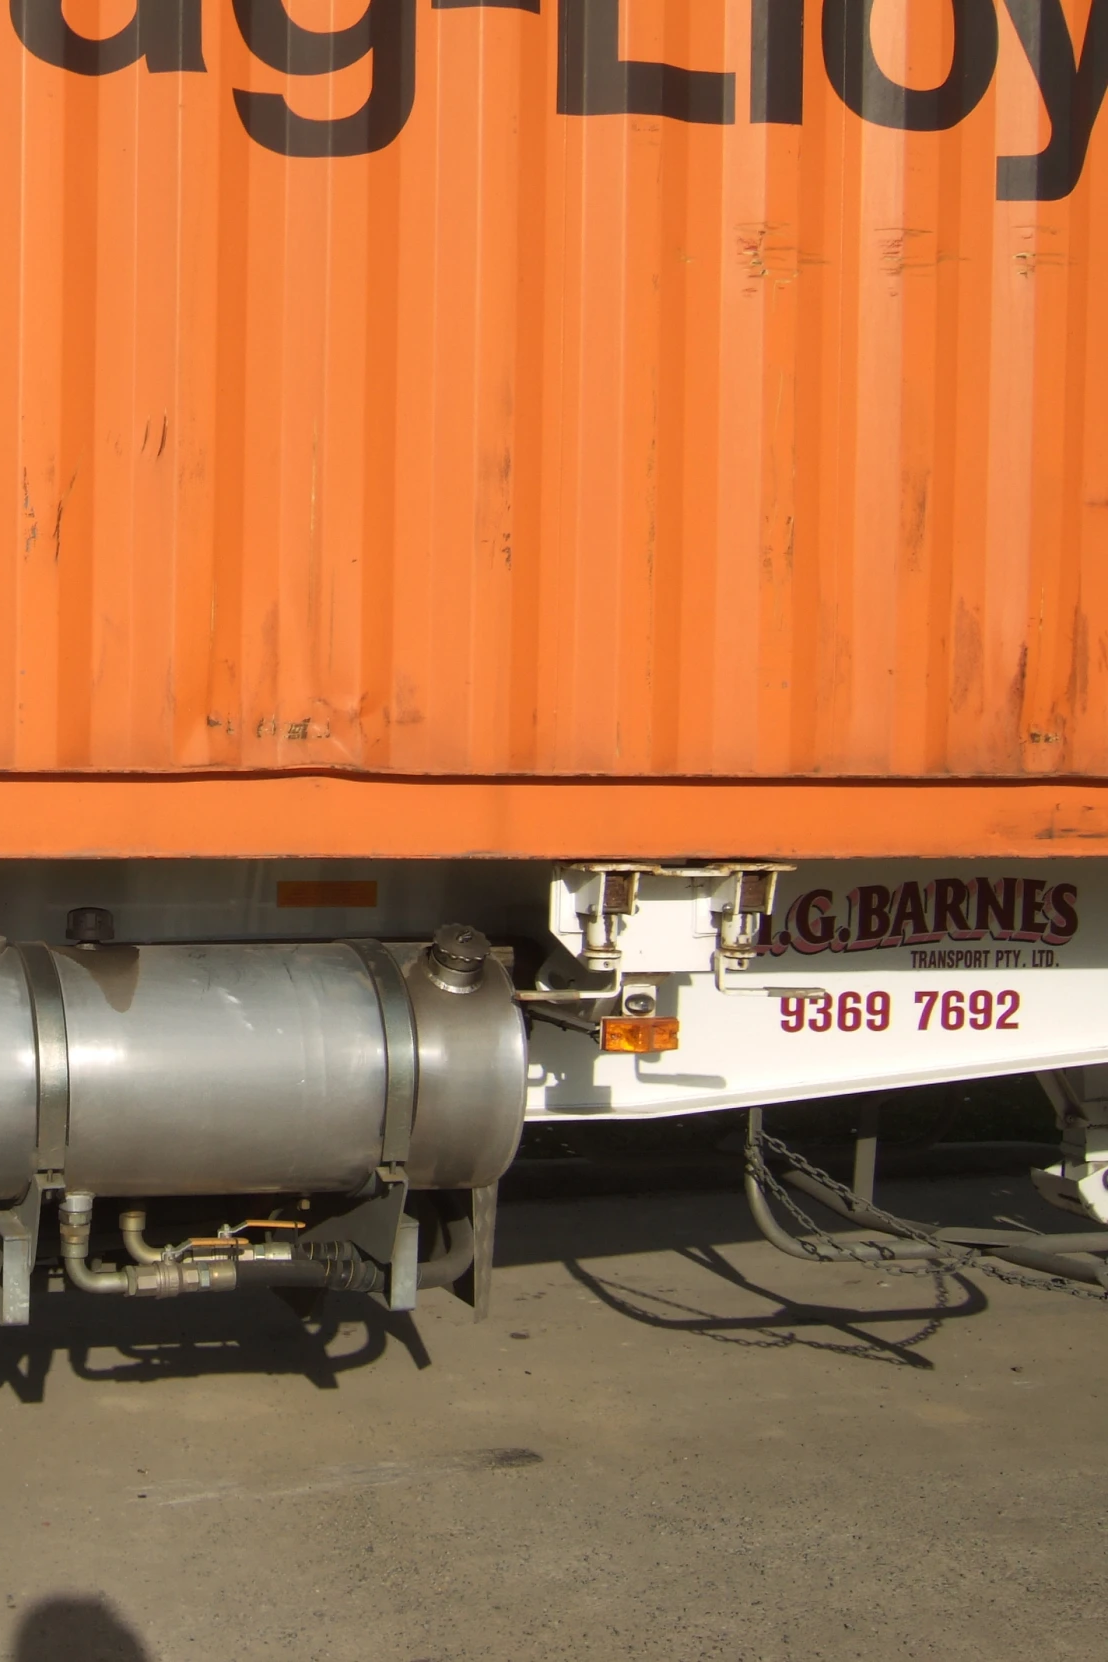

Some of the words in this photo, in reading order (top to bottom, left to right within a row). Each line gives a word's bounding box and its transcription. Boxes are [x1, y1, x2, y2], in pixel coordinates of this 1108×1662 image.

[910, 950, 990, 969] TRANSPORT
[995, 950, 1026, 968] PTY.
[1031, 949, 1060, 968] LTD.
[780, 990, 891, 1033] 9369
[914, 989, 1021, 1031] 7692
